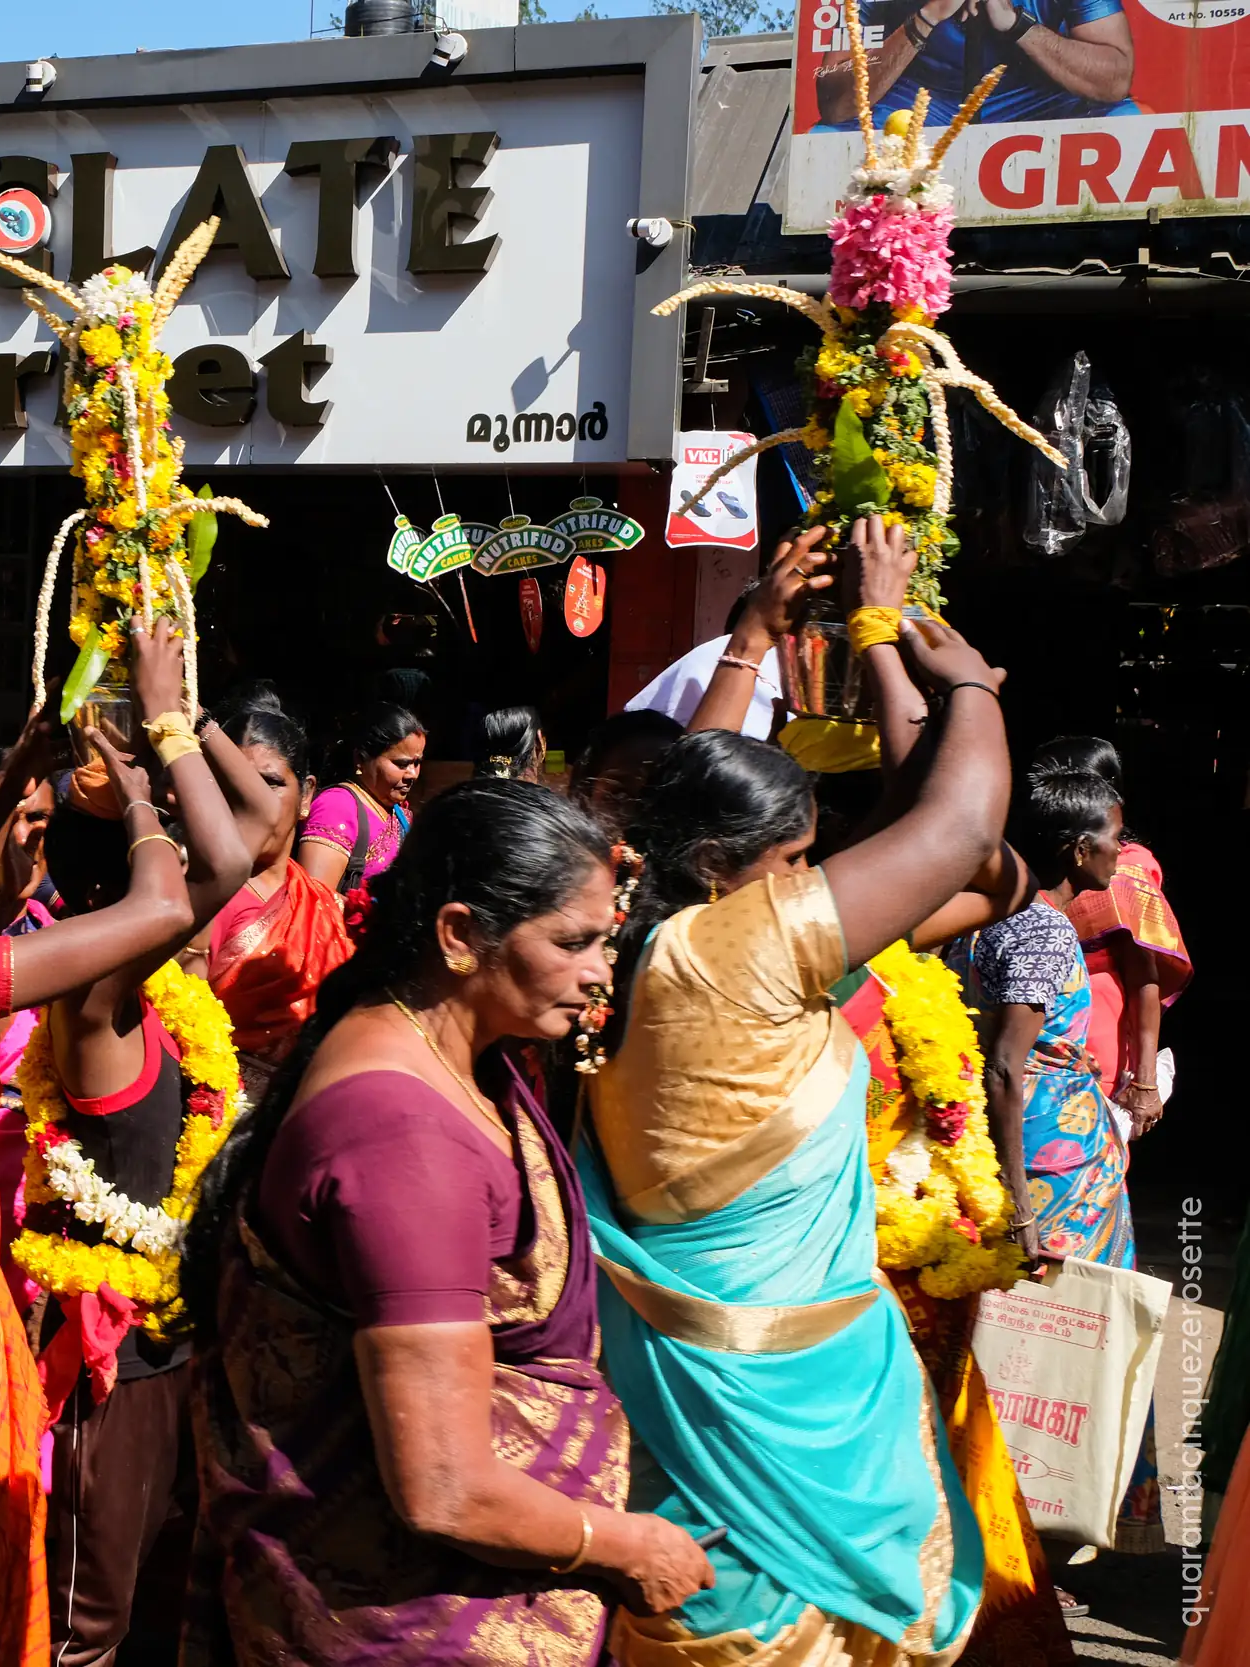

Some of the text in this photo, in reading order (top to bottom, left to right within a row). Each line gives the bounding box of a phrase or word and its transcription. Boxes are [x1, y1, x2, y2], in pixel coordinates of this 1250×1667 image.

[1168, 7, 1246, 21] Art No. 10558
[466, 401, 608, 453] മൂന്നാർ
[687, 449, 719, 464] VKC
[554, 514, 635, 540] UTRIFUD
[478, 532, 566, 568] NUTRIFUD
[577, 538, 603, 549] AKES
[440, 550, 471, 568] CAKES
[507, 555, 538, 568] CAKES
